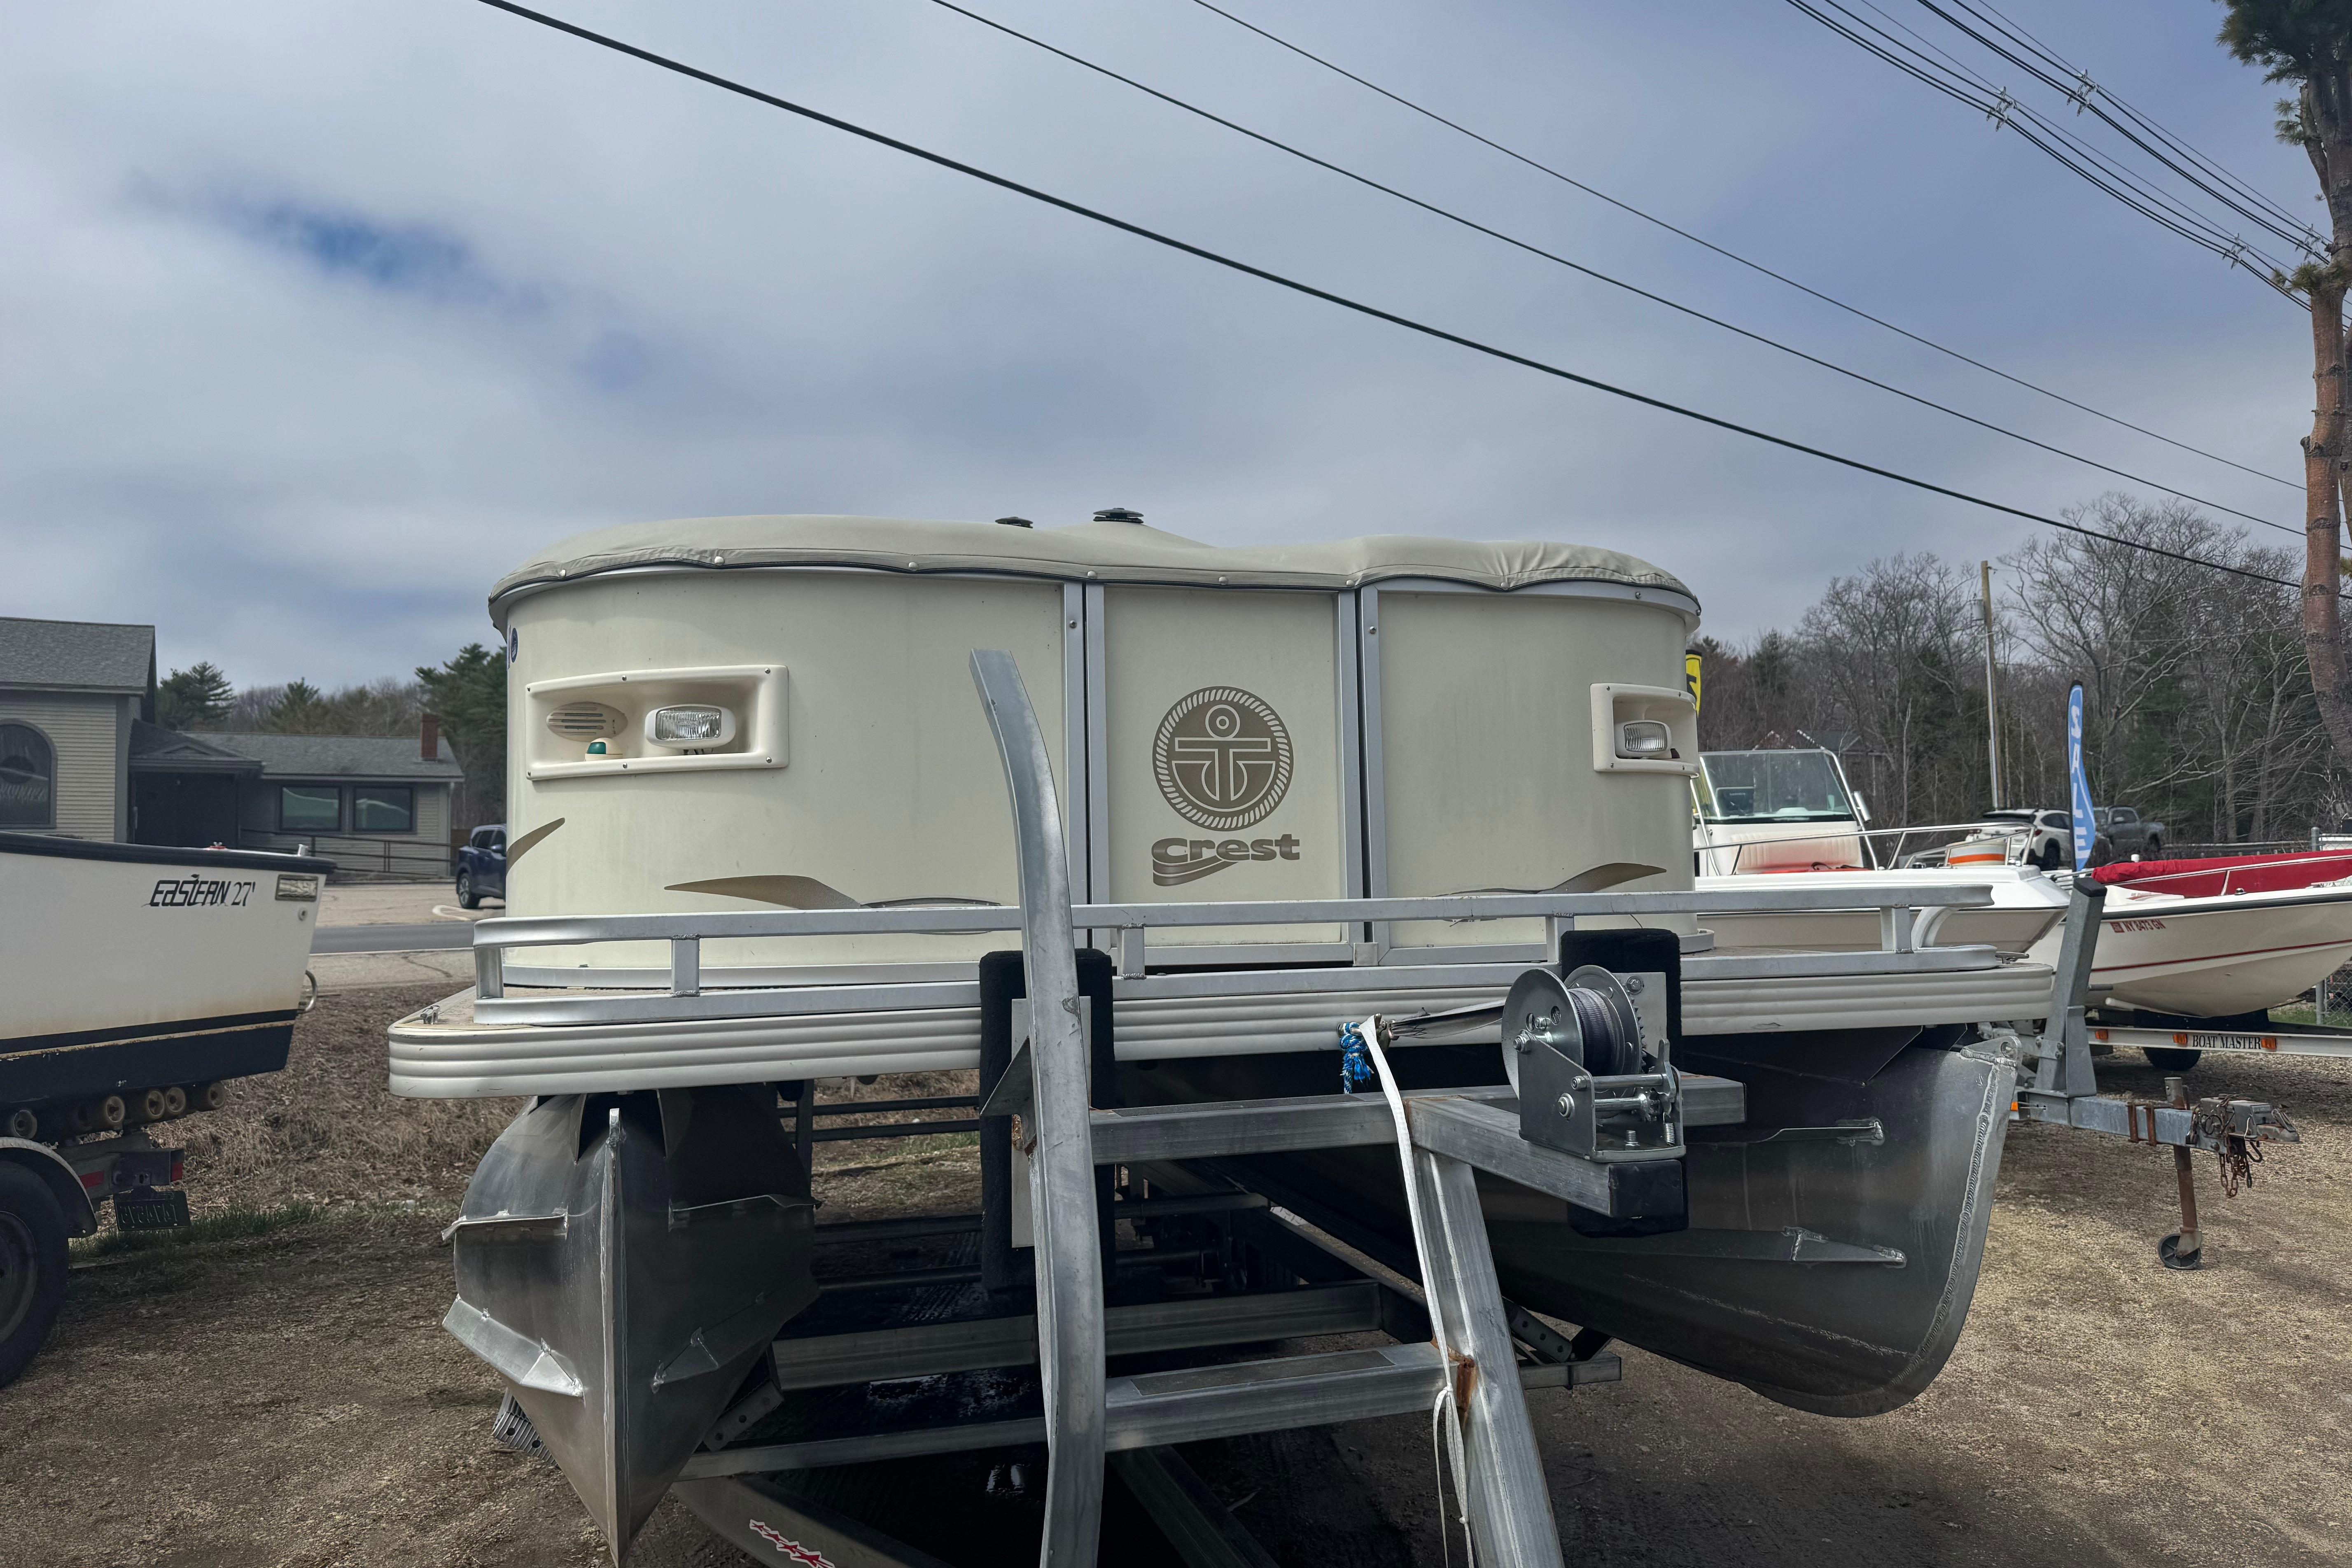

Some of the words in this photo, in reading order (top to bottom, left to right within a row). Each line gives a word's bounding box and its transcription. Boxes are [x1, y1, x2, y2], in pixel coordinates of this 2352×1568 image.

[2071, 705, 2091, 859] SALE
[2192, 1035, 2217, 1048] BOAT
[2220, 1036, 2261, 1050] MASTER
